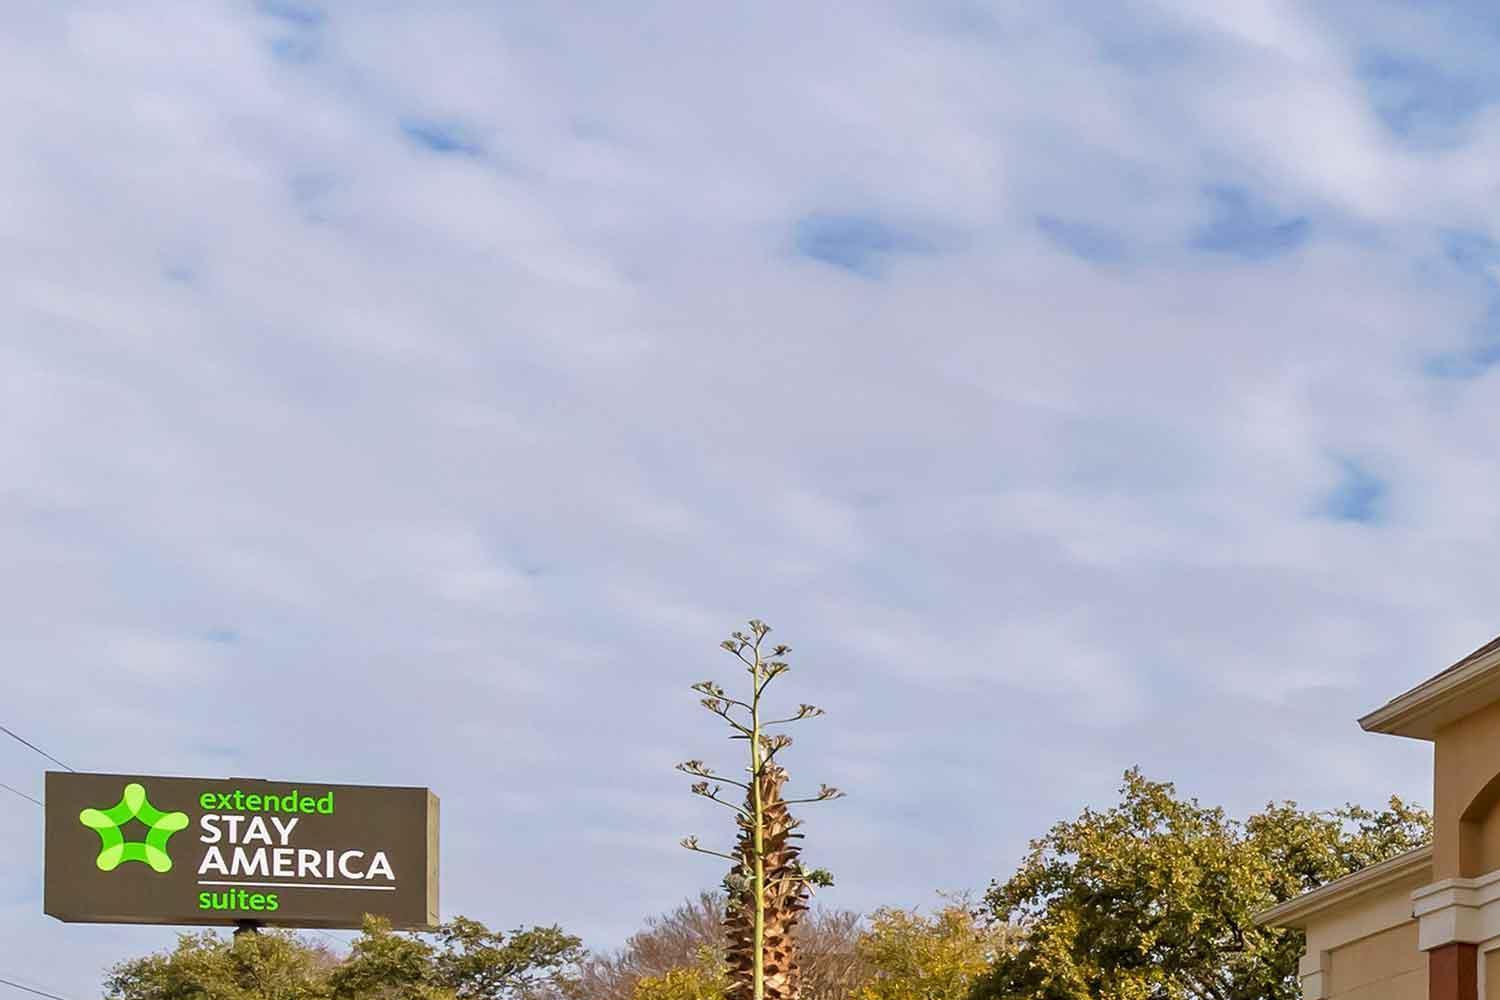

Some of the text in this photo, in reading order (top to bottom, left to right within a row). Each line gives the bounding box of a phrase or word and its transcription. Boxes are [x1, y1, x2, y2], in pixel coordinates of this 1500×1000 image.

[199, 790, 335, 815] extended
[199, 815, 299, 846] STAY
[198, 846, 396, 881] AMERICA
[199, 889, 279, 912] suites
